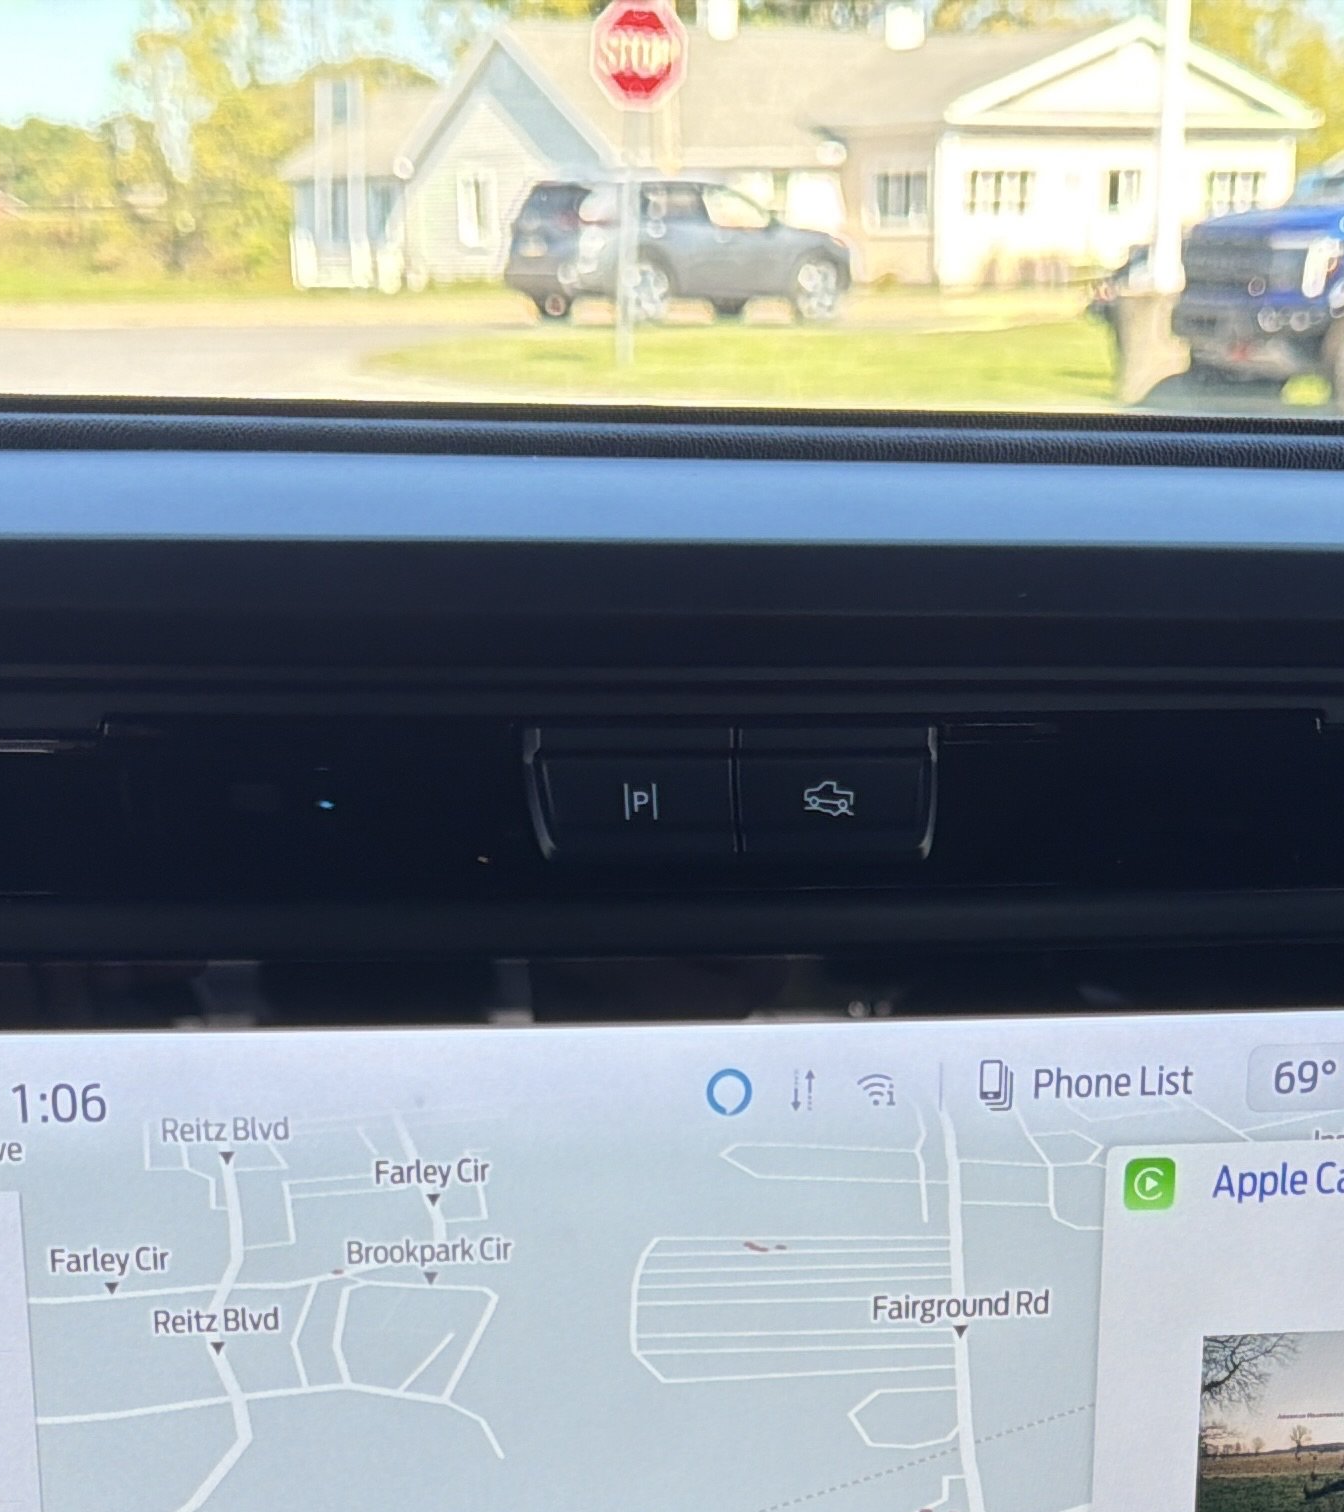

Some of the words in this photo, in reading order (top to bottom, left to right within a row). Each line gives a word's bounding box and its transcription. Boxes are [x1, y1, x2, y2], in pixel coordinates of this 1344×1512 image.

[1033, 1067, 1131, 1100] Phone
[1140, 1064, 1194, 1097] List
[1274, 1059, 1337, 1095] 69°
[11, 1083, 108, 1124] 1:06
[161, 1117, 227, 1143] Reitz
[233, 1116, 290, 1142] Blvd
[375, 1159, 453, 1189] Farley
[457, 1158, 490, 1184] Cir
[1212, 1163, 1308, 1204] Apple
[50, 1247, 130, 1276] Farley
[135, 1246, 170, 1272] Cir
[347, 1237, 475, 1270] Brookpark
[479, 1236, 513, 1262] Cir
[153, 1309, 217, 1334] Reitz
[223, 1306, 280, 1333] Blvd
[873, 1290, 1010, 1324] Fairground
[1016, 1289, 1050, 1316] Rd
